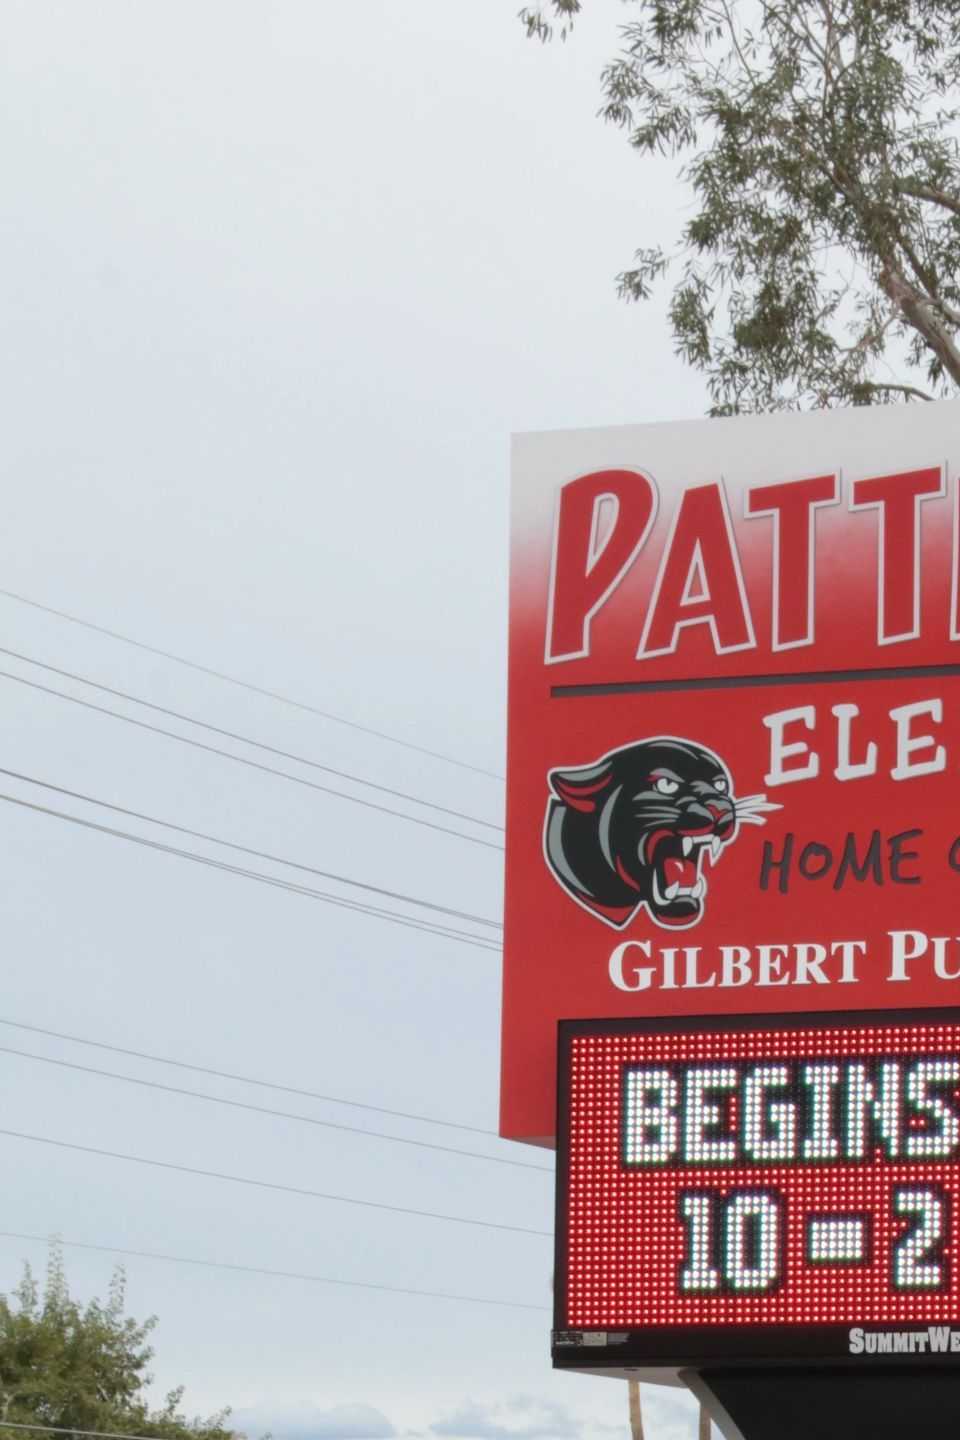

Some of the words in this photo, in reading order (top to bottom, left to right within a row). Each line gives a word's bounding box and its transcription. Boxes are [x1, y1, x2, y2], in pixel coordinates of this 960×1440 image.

[759, 829, 923, 894] HOME
[607, 939, 866, 993] GILBERT
[624, 1059, 960, 1165] BEGINS
